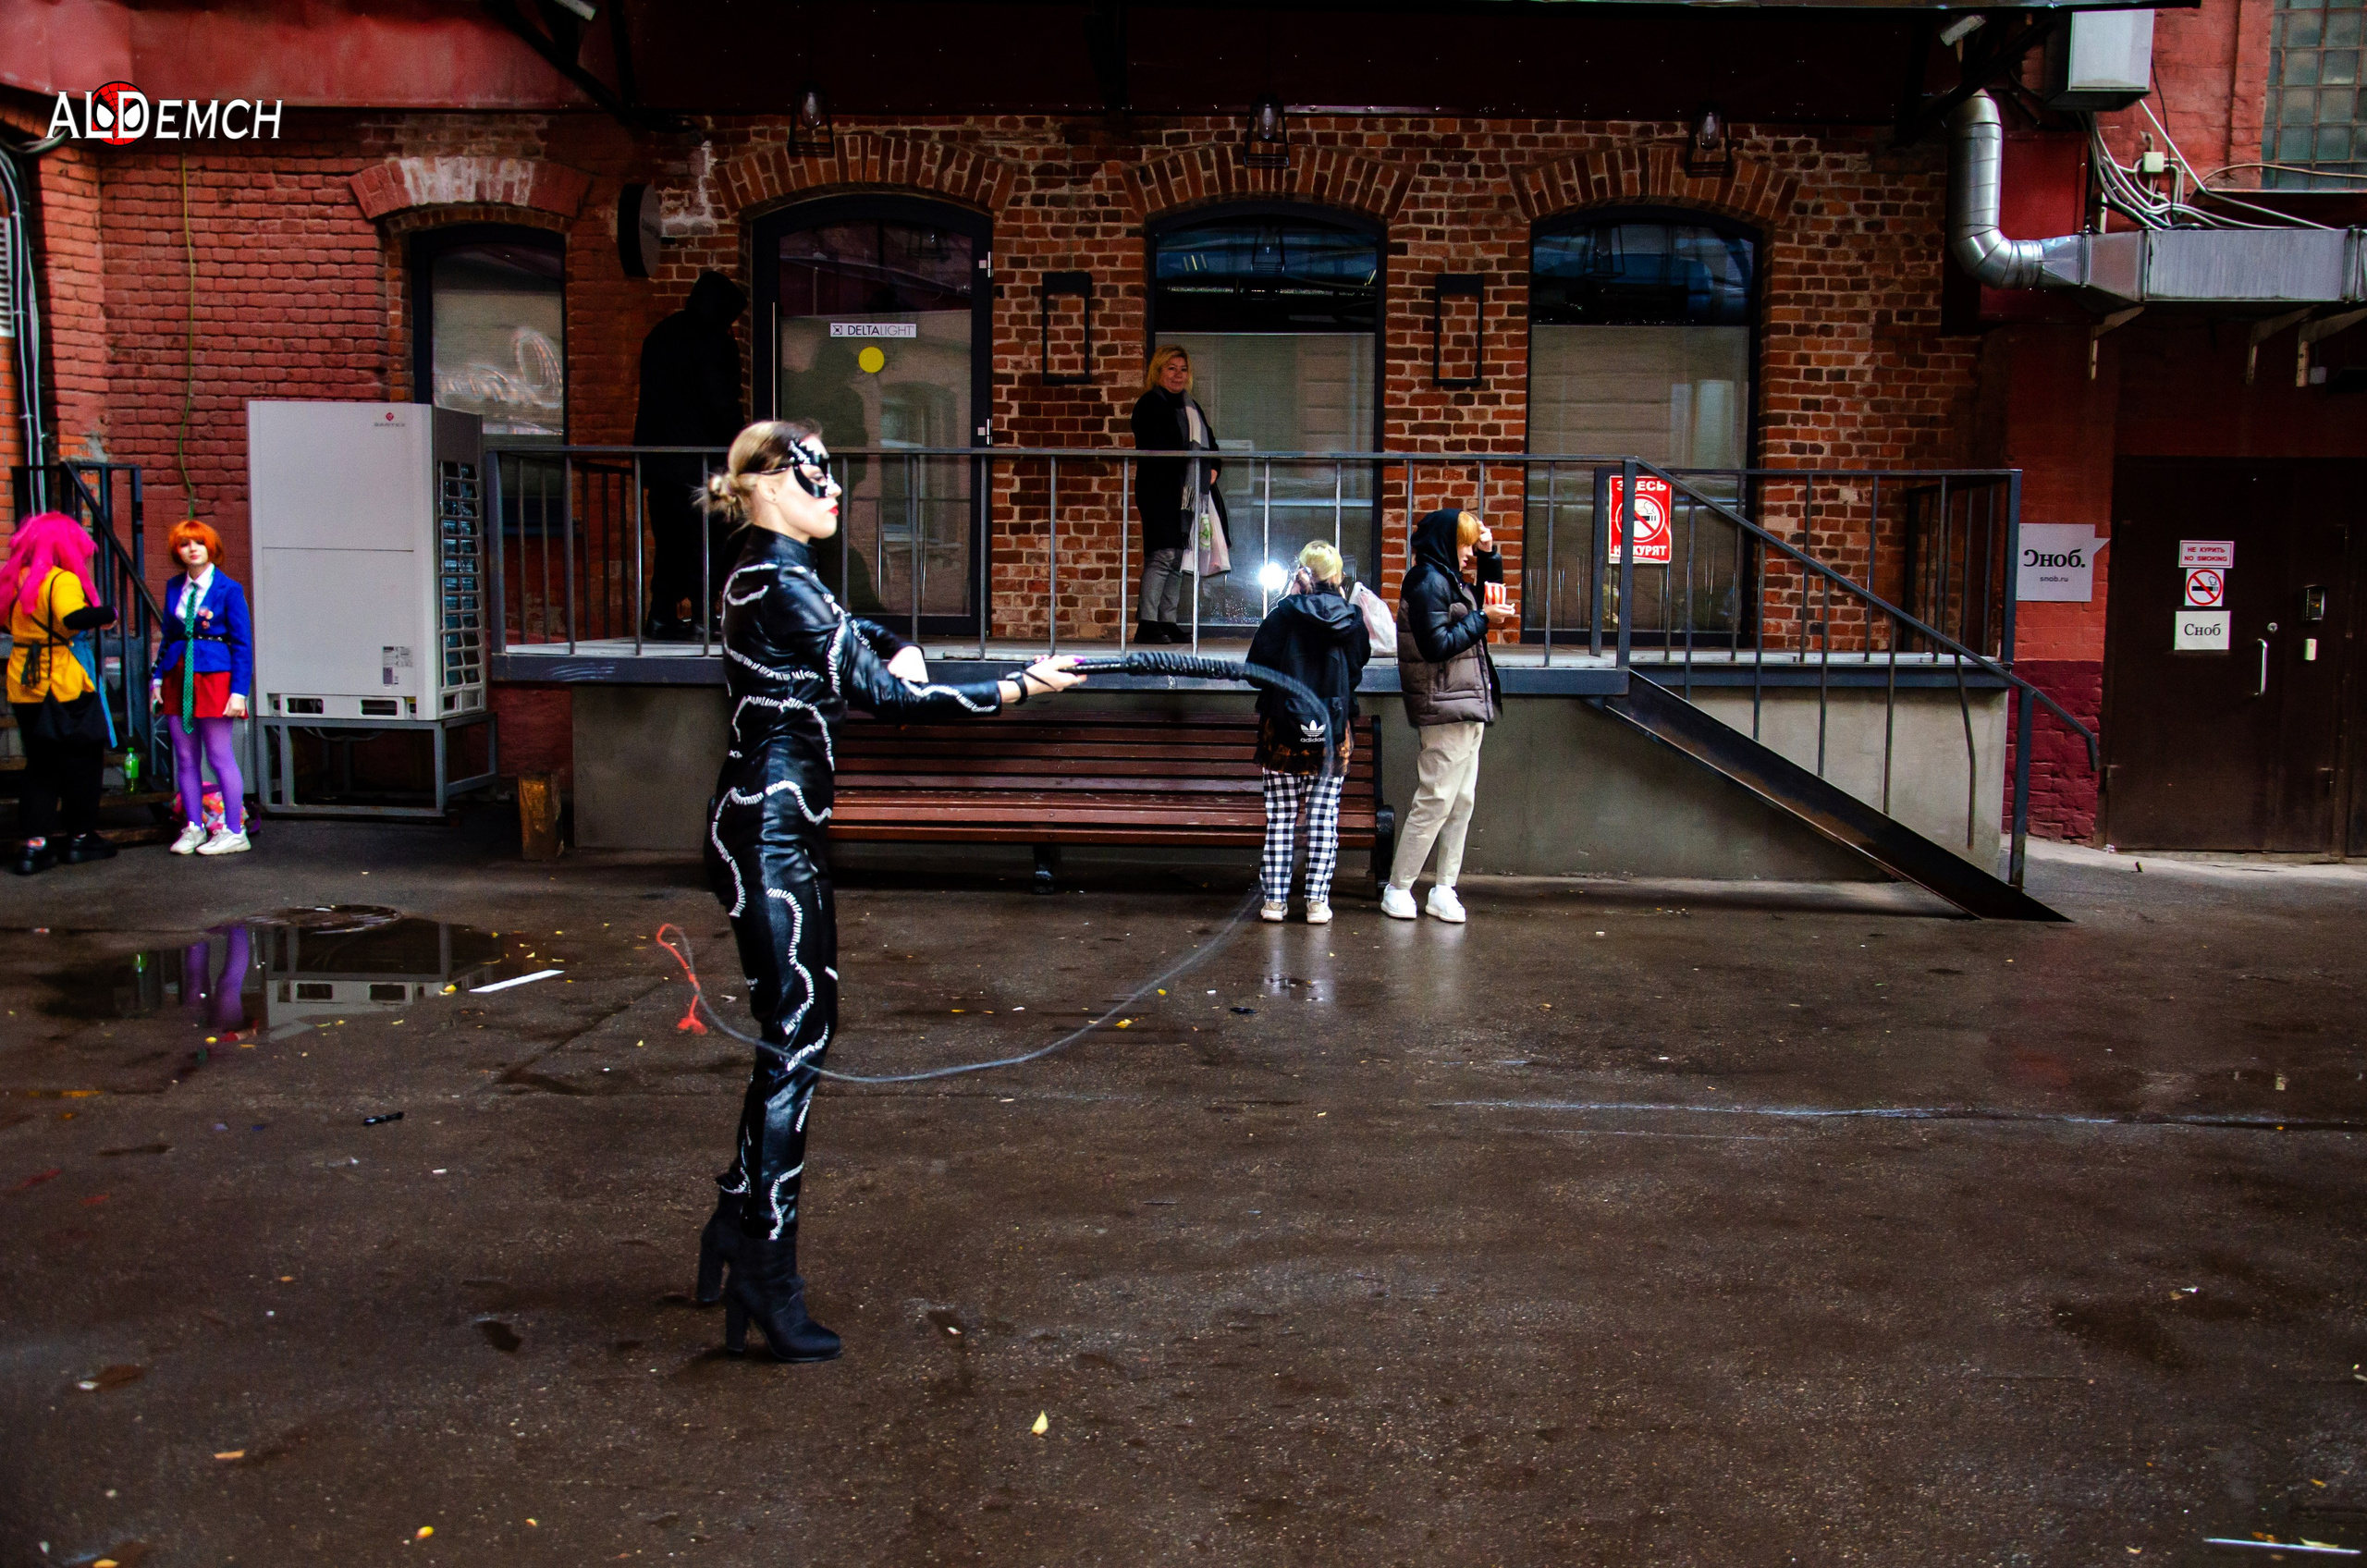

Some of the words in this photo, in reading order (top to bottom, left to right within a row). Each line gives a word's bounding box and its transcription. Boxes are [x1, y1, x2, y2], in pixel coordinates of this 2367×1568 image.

[848, 325, 914, 337] DELTALIGHT
[1616, 480, 1667, 492] ЗЕСЬ
[2184, 623, 2222, 636] Сноб
